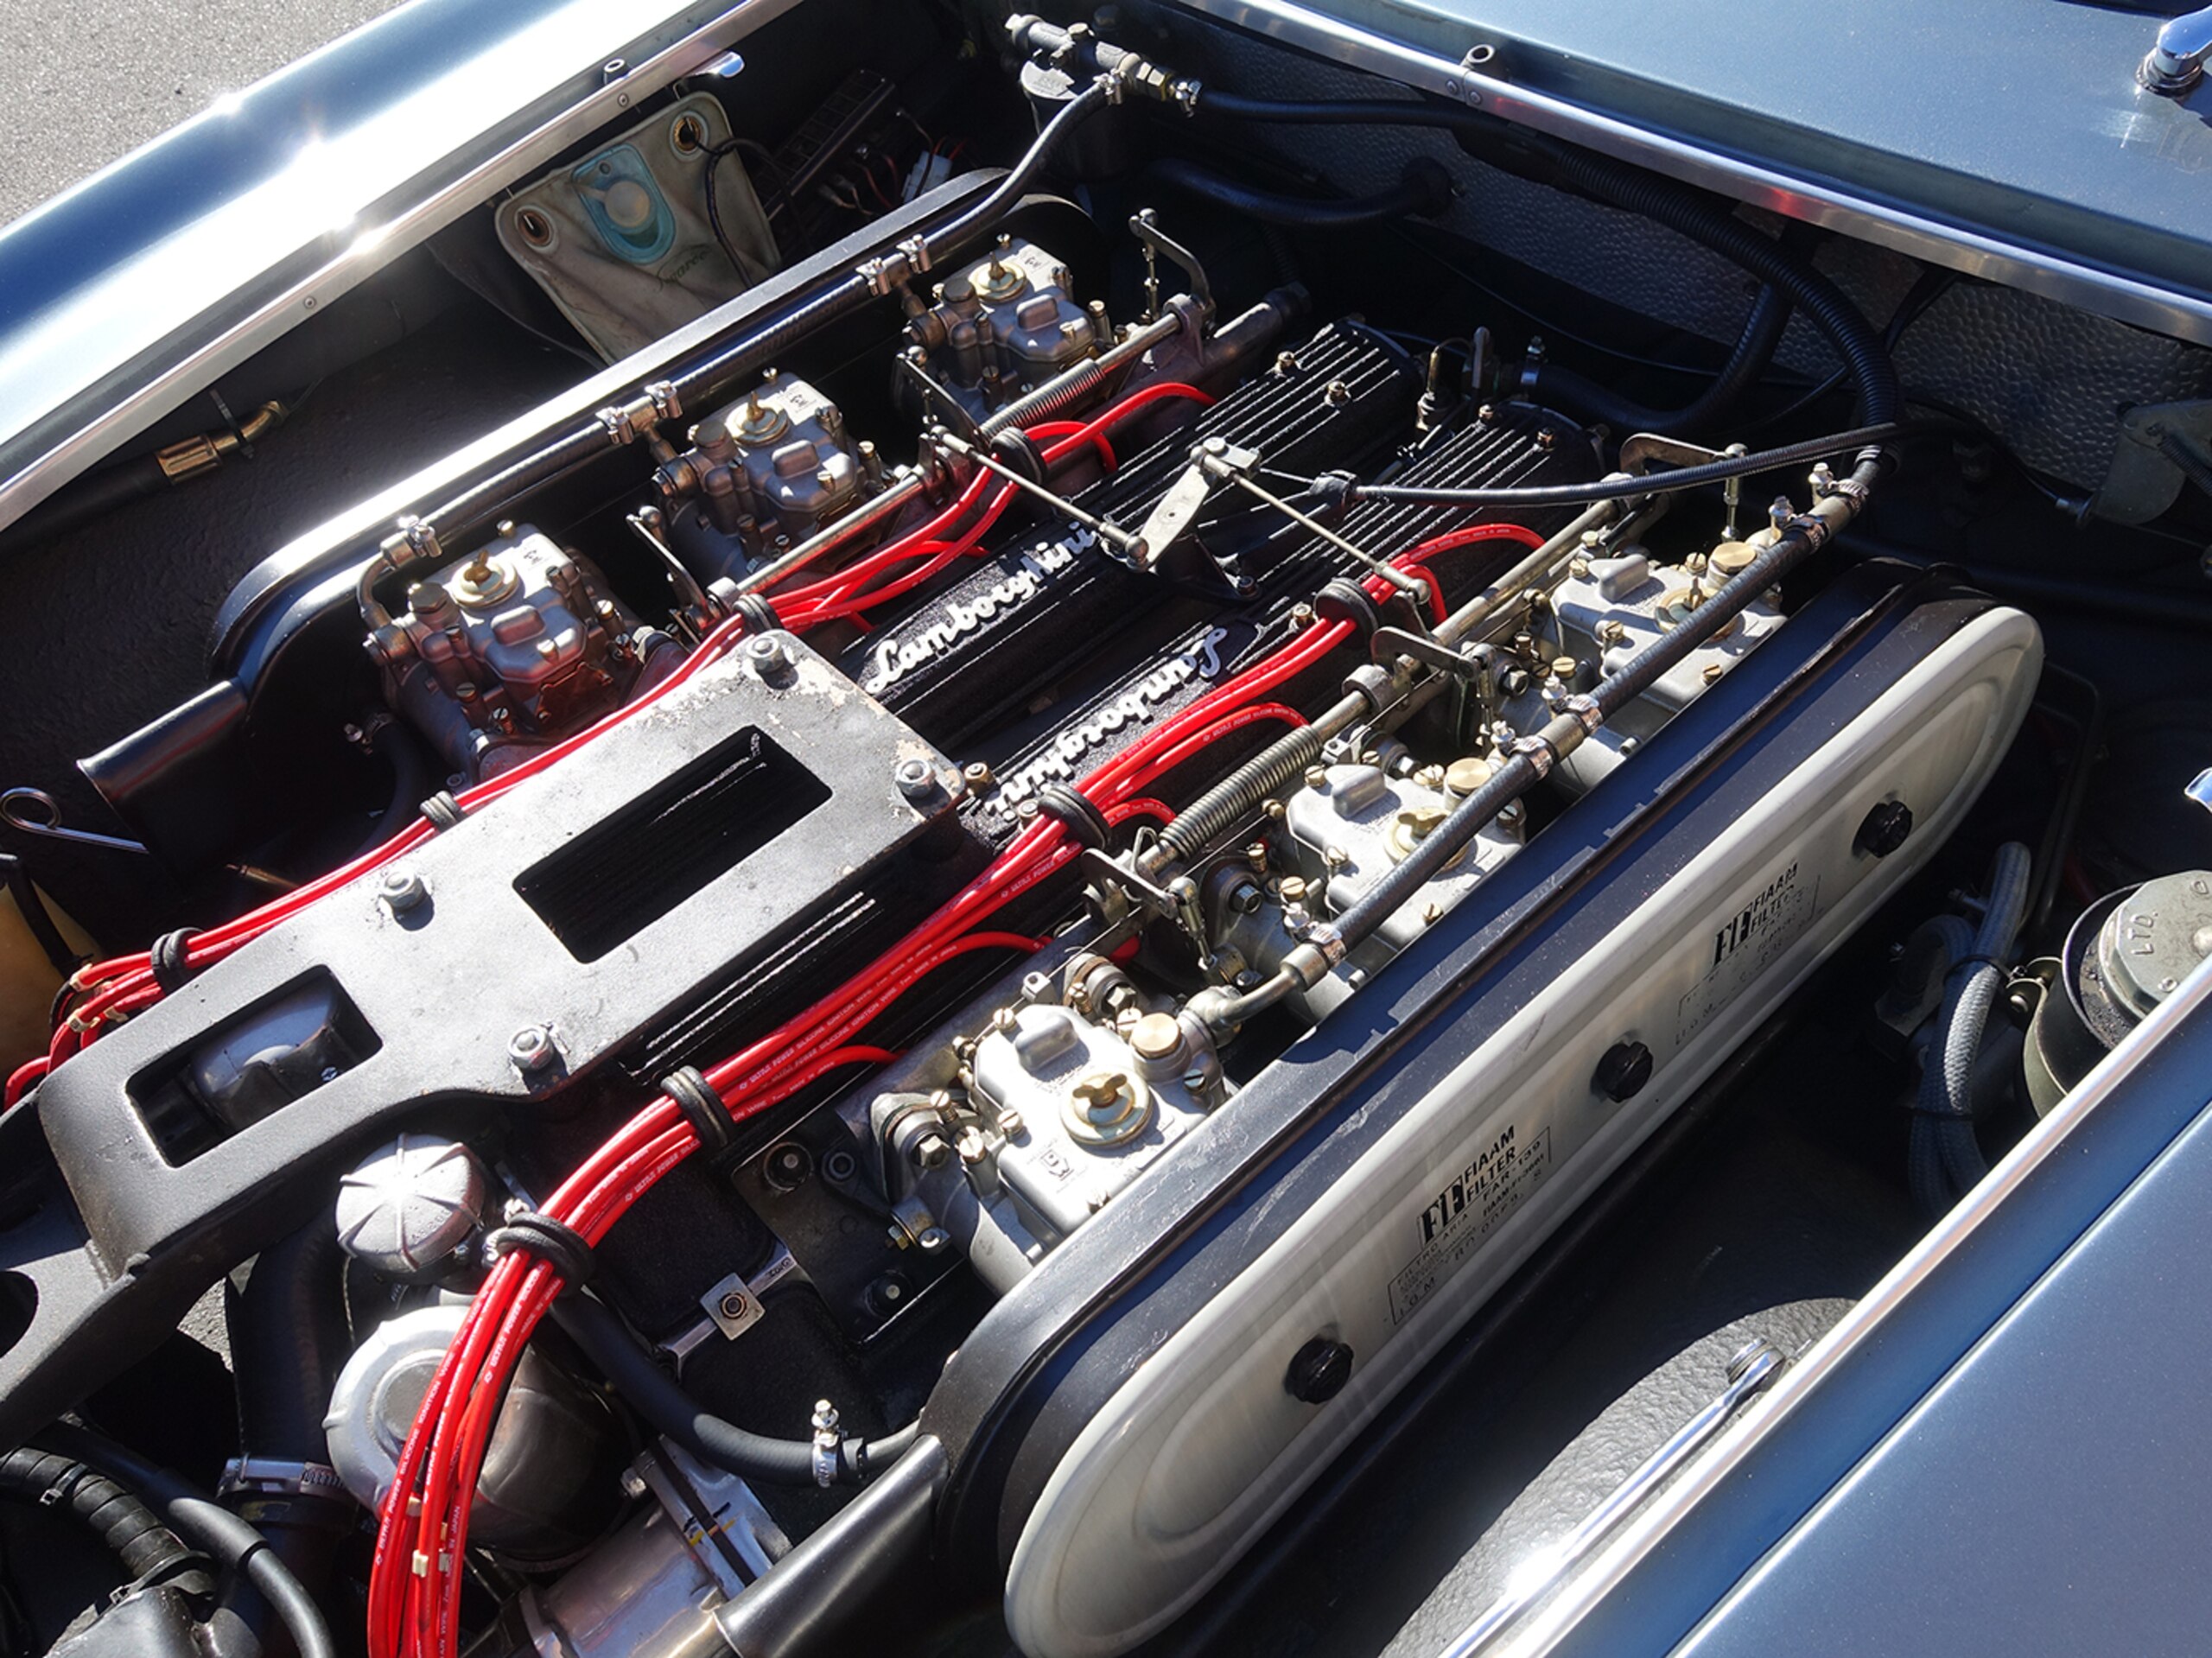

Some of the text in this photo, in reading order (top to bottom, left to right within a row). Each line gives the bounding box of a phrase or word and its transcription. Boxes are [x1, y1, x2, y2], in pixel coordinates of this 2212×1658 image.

[865, 522, 1096, 694] Lamborghini
[985, 627, 1228, 822] Lamborghini
[1464, 1124, 1515, 1185] FIAAM
[1466, 1146, 1516, 1203] FILTER
[386, 1477, 404, 1514] POWER
[398, 1427, 421, 1476] SILICONE
[416, 1379, 442, 1426] IGNITION
[437, 1350, 455, 1378] WIRE
